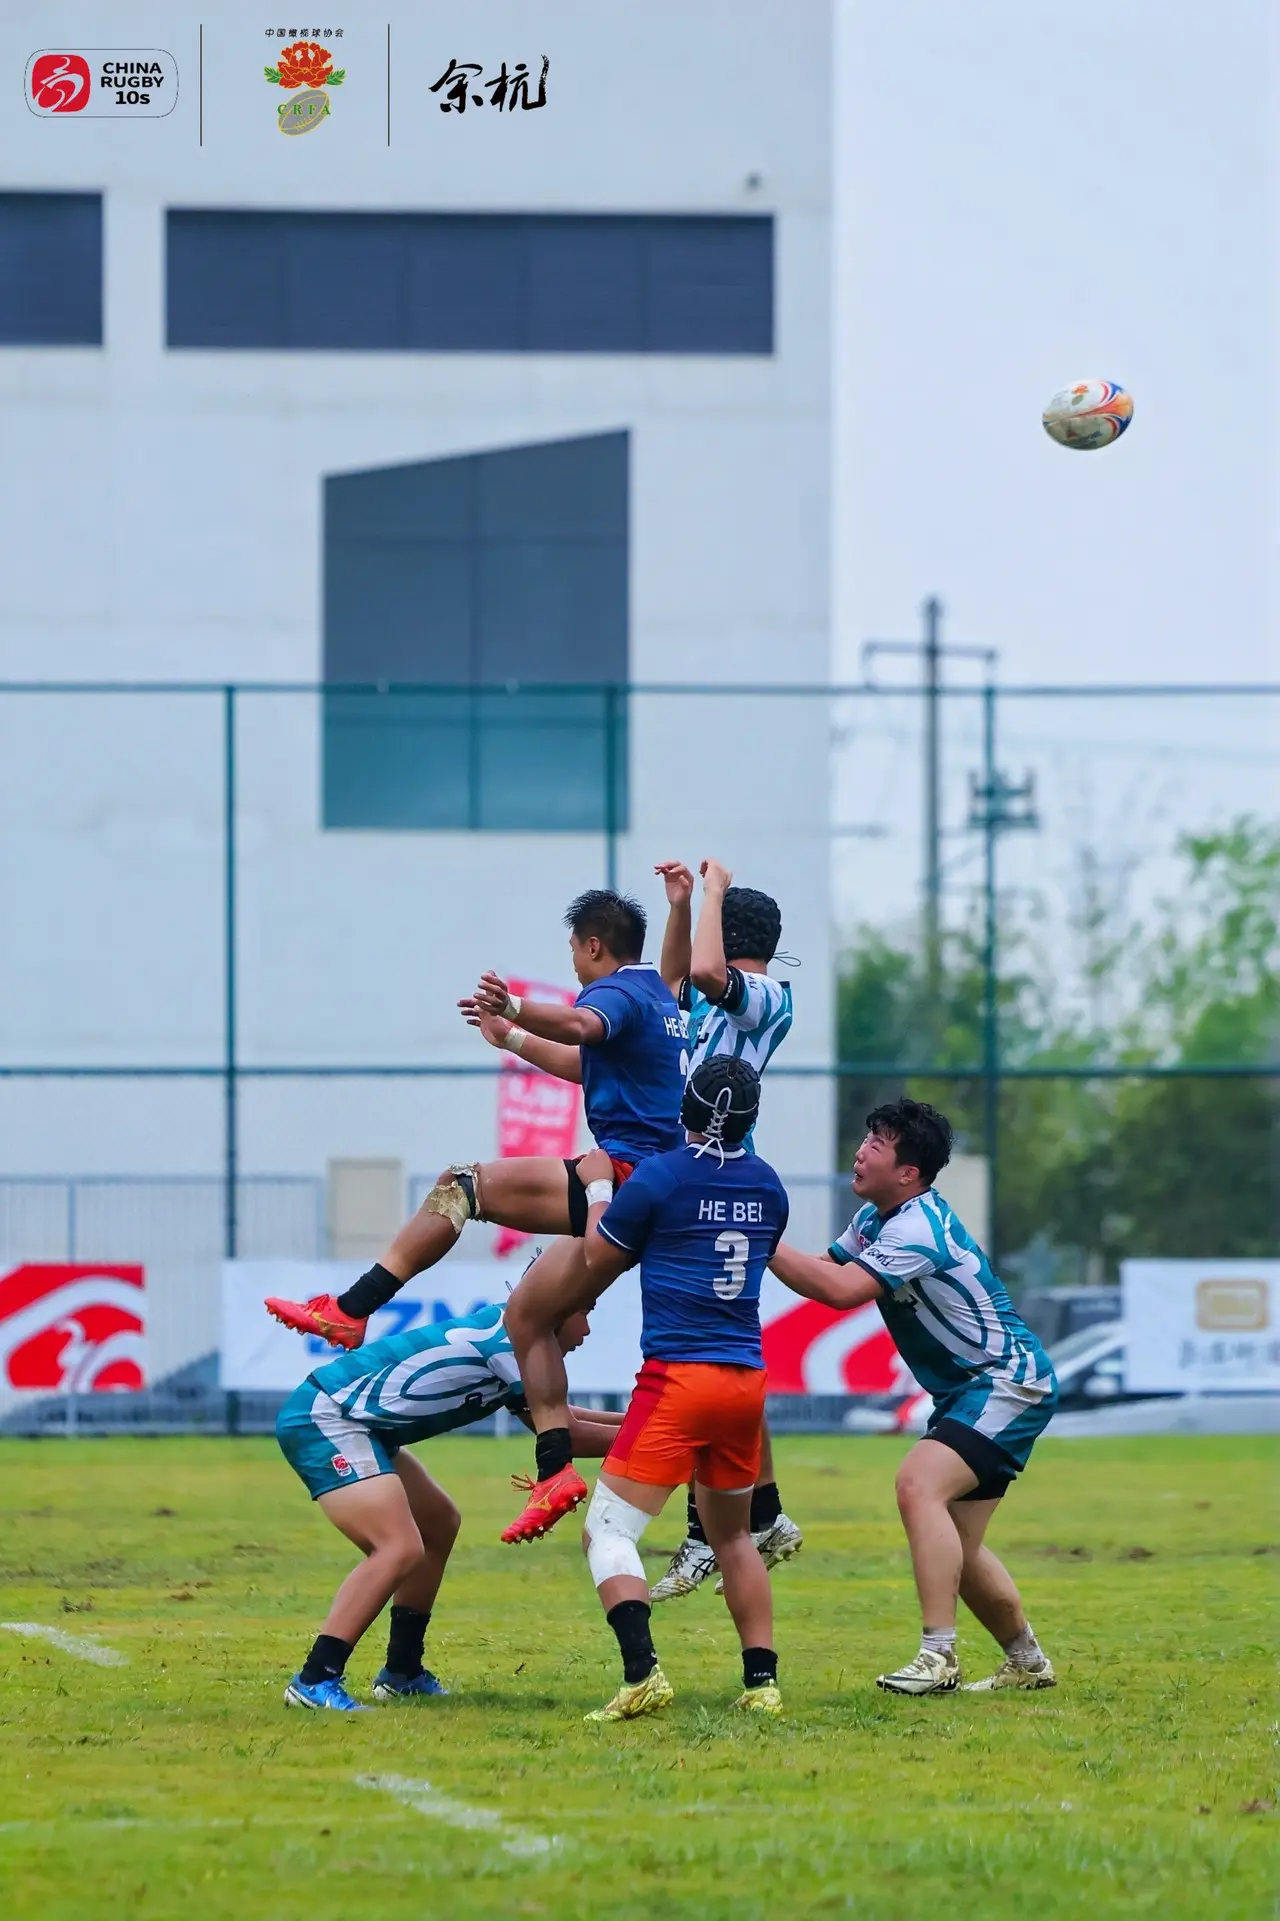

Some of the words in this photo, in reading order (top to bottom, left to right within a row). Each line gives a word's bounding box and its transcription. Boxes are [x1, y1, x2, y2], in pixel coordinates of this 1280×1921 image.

[698, 1199, 726, 1221] HE
[732, 1201, 762, 1223] BEI
[712, 1230, 750, 1301] 3
